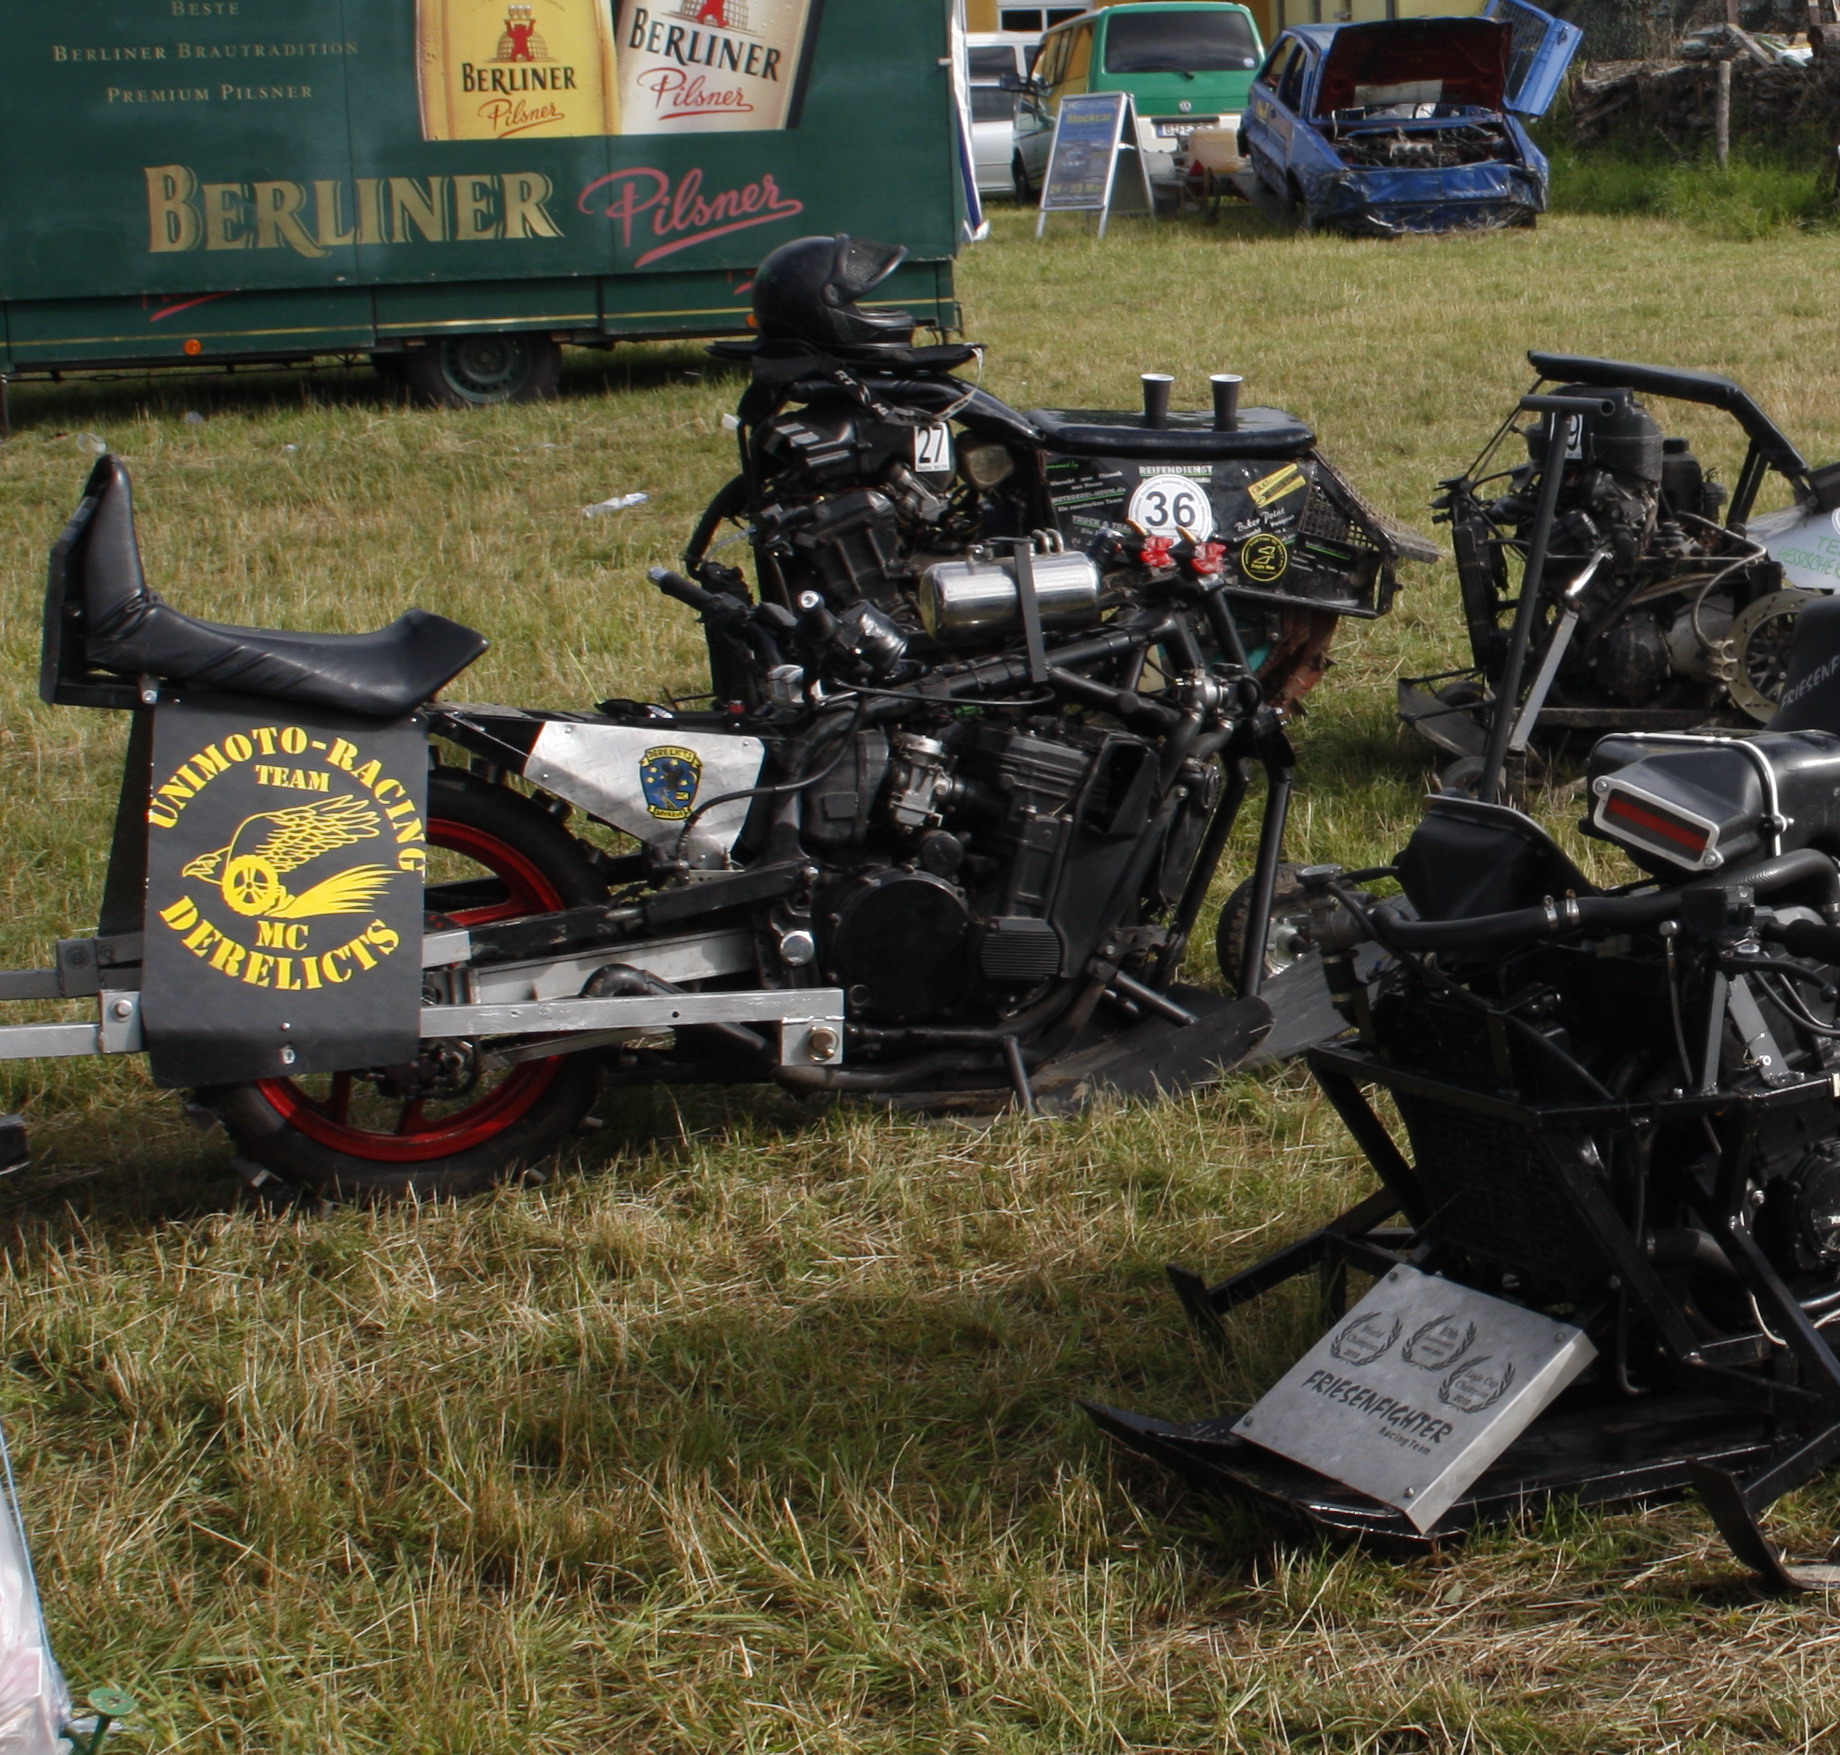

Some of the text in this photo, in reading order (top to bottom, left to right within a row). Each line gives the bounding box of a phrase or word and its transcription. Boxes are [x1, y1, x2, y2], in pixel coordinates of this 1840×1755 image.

[52, 42, 359, 62] BERLINER BRAUTRADITION
[629, 8, 782, 82] BERLINER
[106, 84, 312, 103] PREMIUM PILSNER
[461, 62, 577, 96] BERLINER
[637, 67, 754, 121] Pilsner
[477, 98, 566, 138] Pilsner
[143, 163, 804, 269] BERLINER Pilsner
[917, 425, 945, 464] 27
[1139, 465, 1213, 474] REIFENDIENST
[1144, 490, 1196, 528] 36
[255, 764, 330, 792] TEAM
[148, 726, 427, 872] UNIMOTO-RACING
[159, 895, 400, 991] DERELICTS
[256, 919, 309, 951] MC
[1301, 1369, 1454, 1443] FRIESENFIGHTER
[1378, 1426, 1432, 1455] Racing Team
